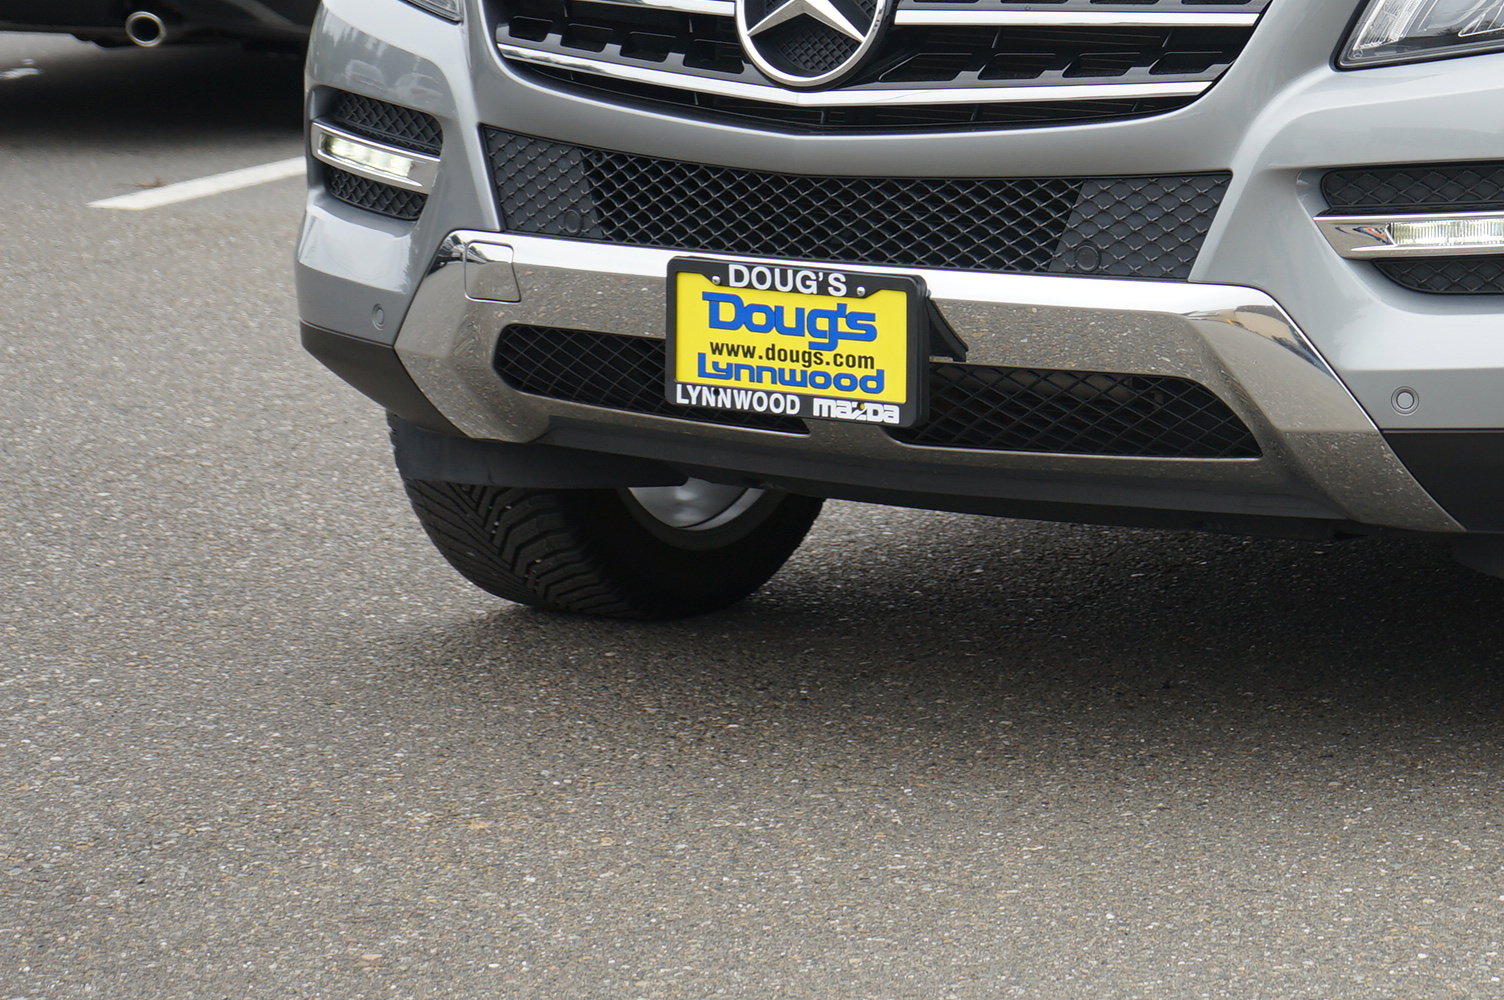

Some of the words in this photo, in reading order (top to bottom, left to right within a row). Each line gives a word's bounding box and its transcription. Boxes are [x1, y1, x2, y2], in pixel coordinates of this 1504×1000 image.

[728, 264, 848, 297] DOUG'S
[710, 342, 875, 370] www.dougs.com
[697, 352, 885, 394] Lynnwood
[676, 384, 800, 415] LYNNWOOD
